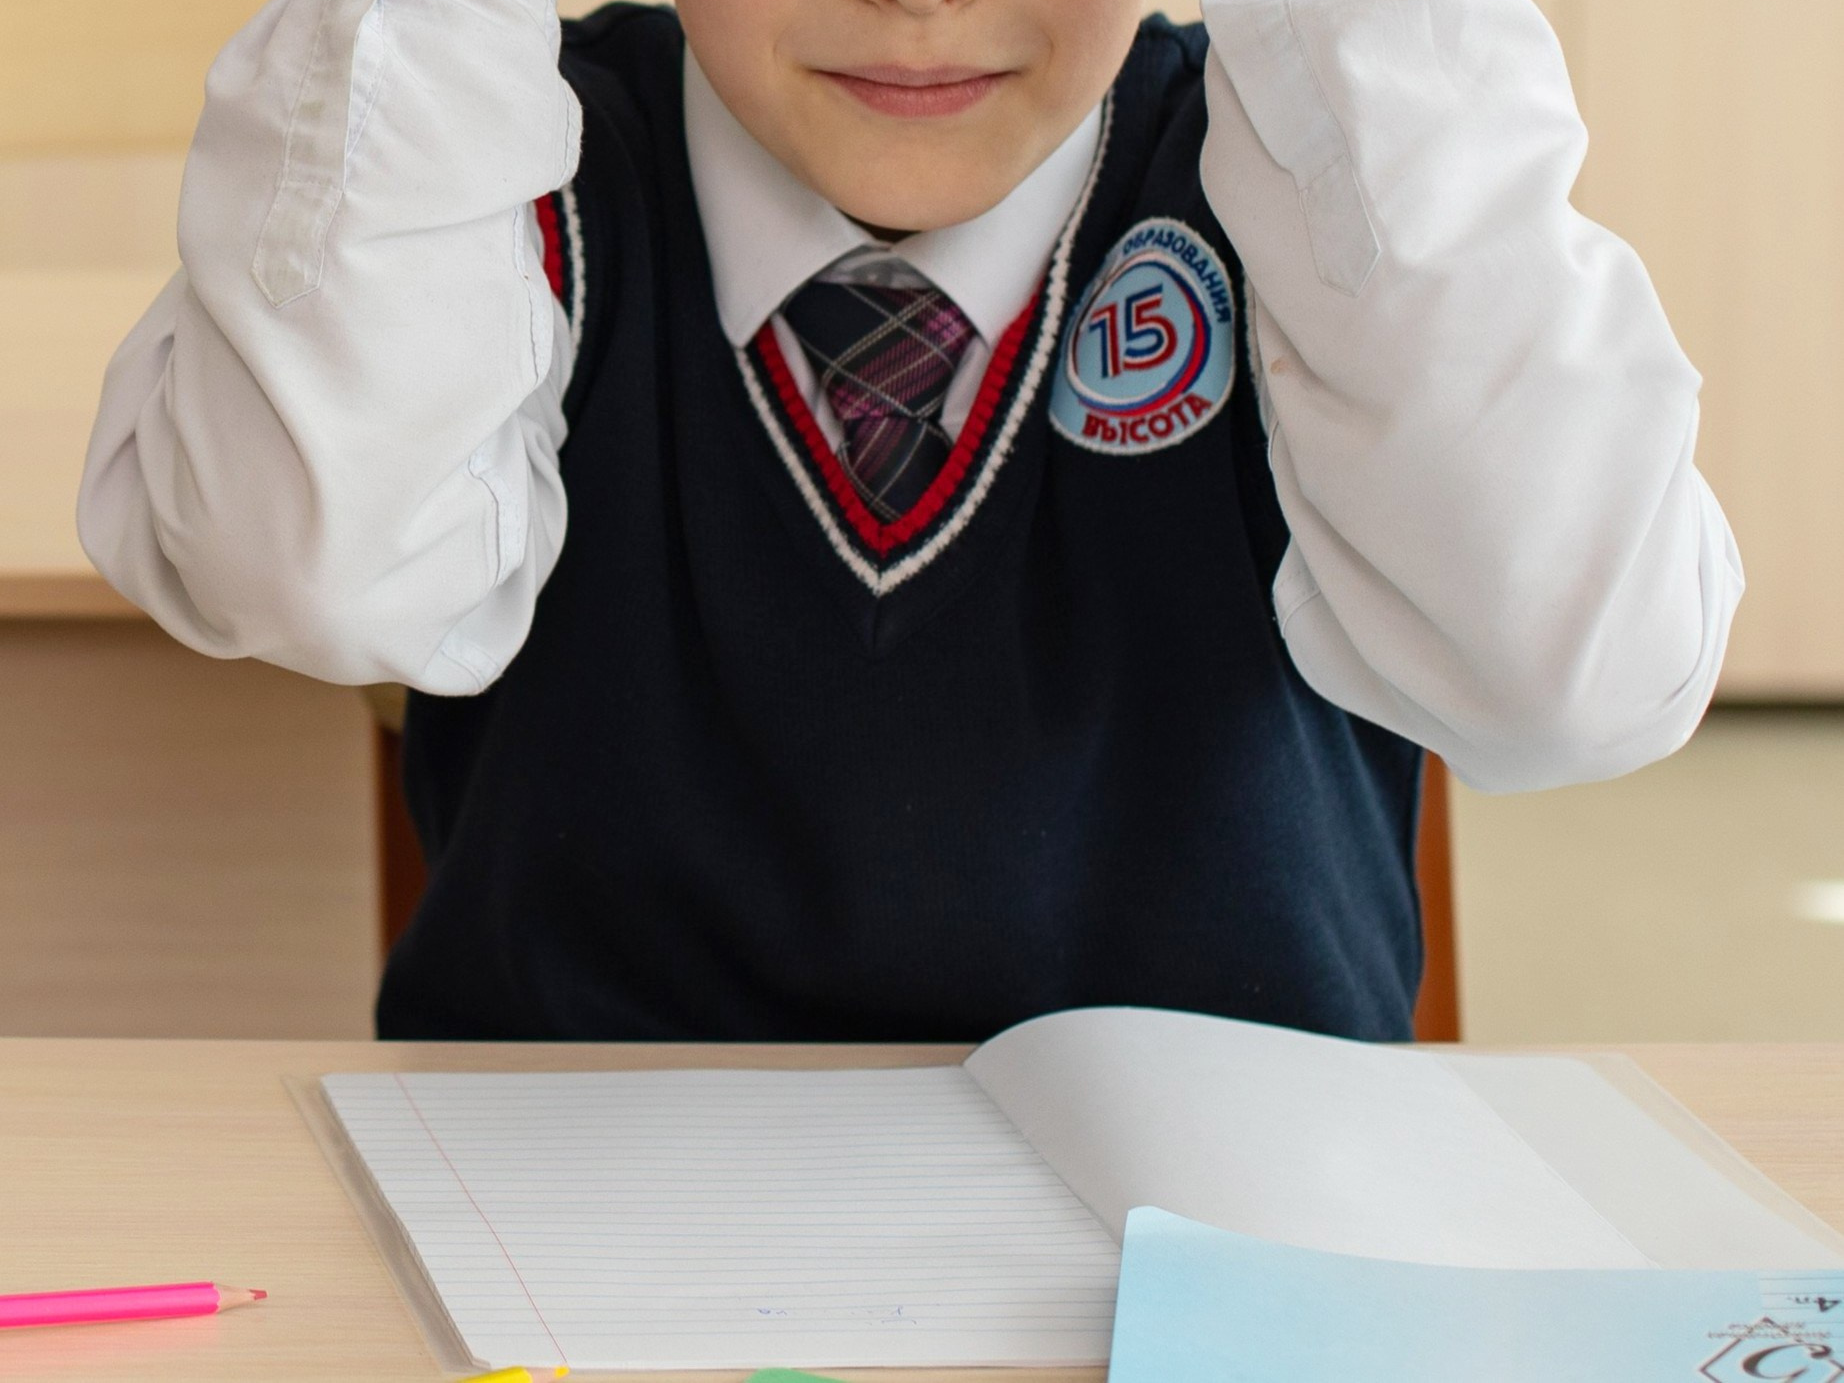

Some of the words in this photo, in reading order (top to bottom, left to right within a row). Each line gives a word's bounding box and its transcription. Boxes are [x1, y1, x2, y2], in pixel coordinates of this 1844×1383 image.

[1122, 228, 1232, 323] ОБРАЗОВАНИЯ
[1088, 283, 1179, 379] 15
[1082, 391, 1213, 445] ВЫСОТА
